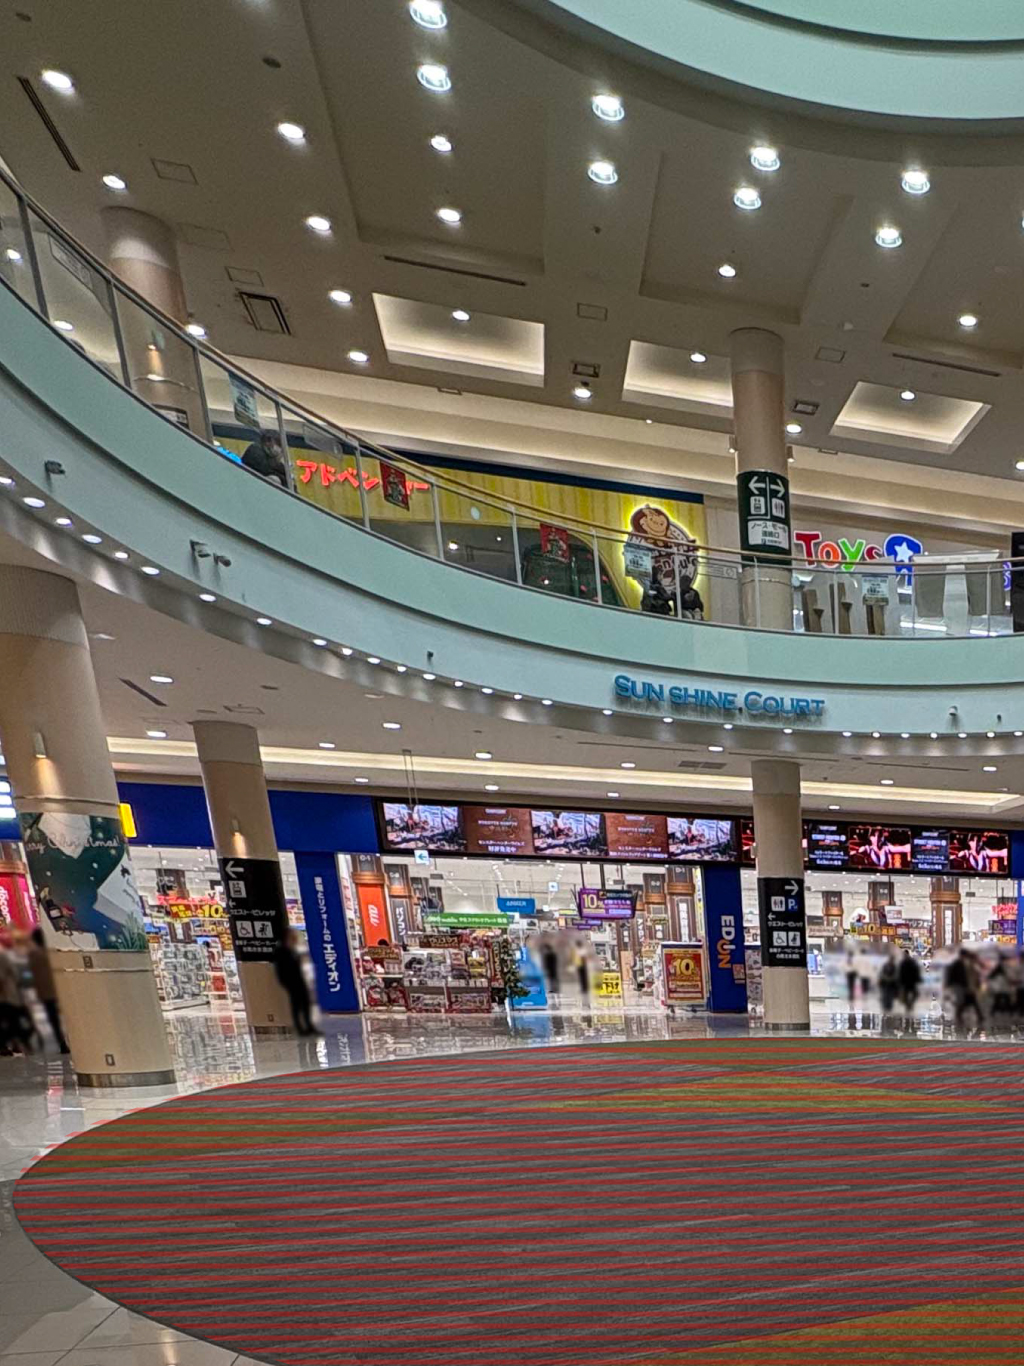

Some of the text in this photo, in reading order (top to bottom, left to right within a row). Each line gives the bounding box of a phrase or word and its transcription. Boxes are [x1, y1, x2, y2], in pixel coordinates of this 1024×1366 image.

[296, 459, 430, 495] アドベンー
[367, 904, 379, 927] au
[717, 915, 736, 968] EDION
[323, 943, 341, 993] エディオン
